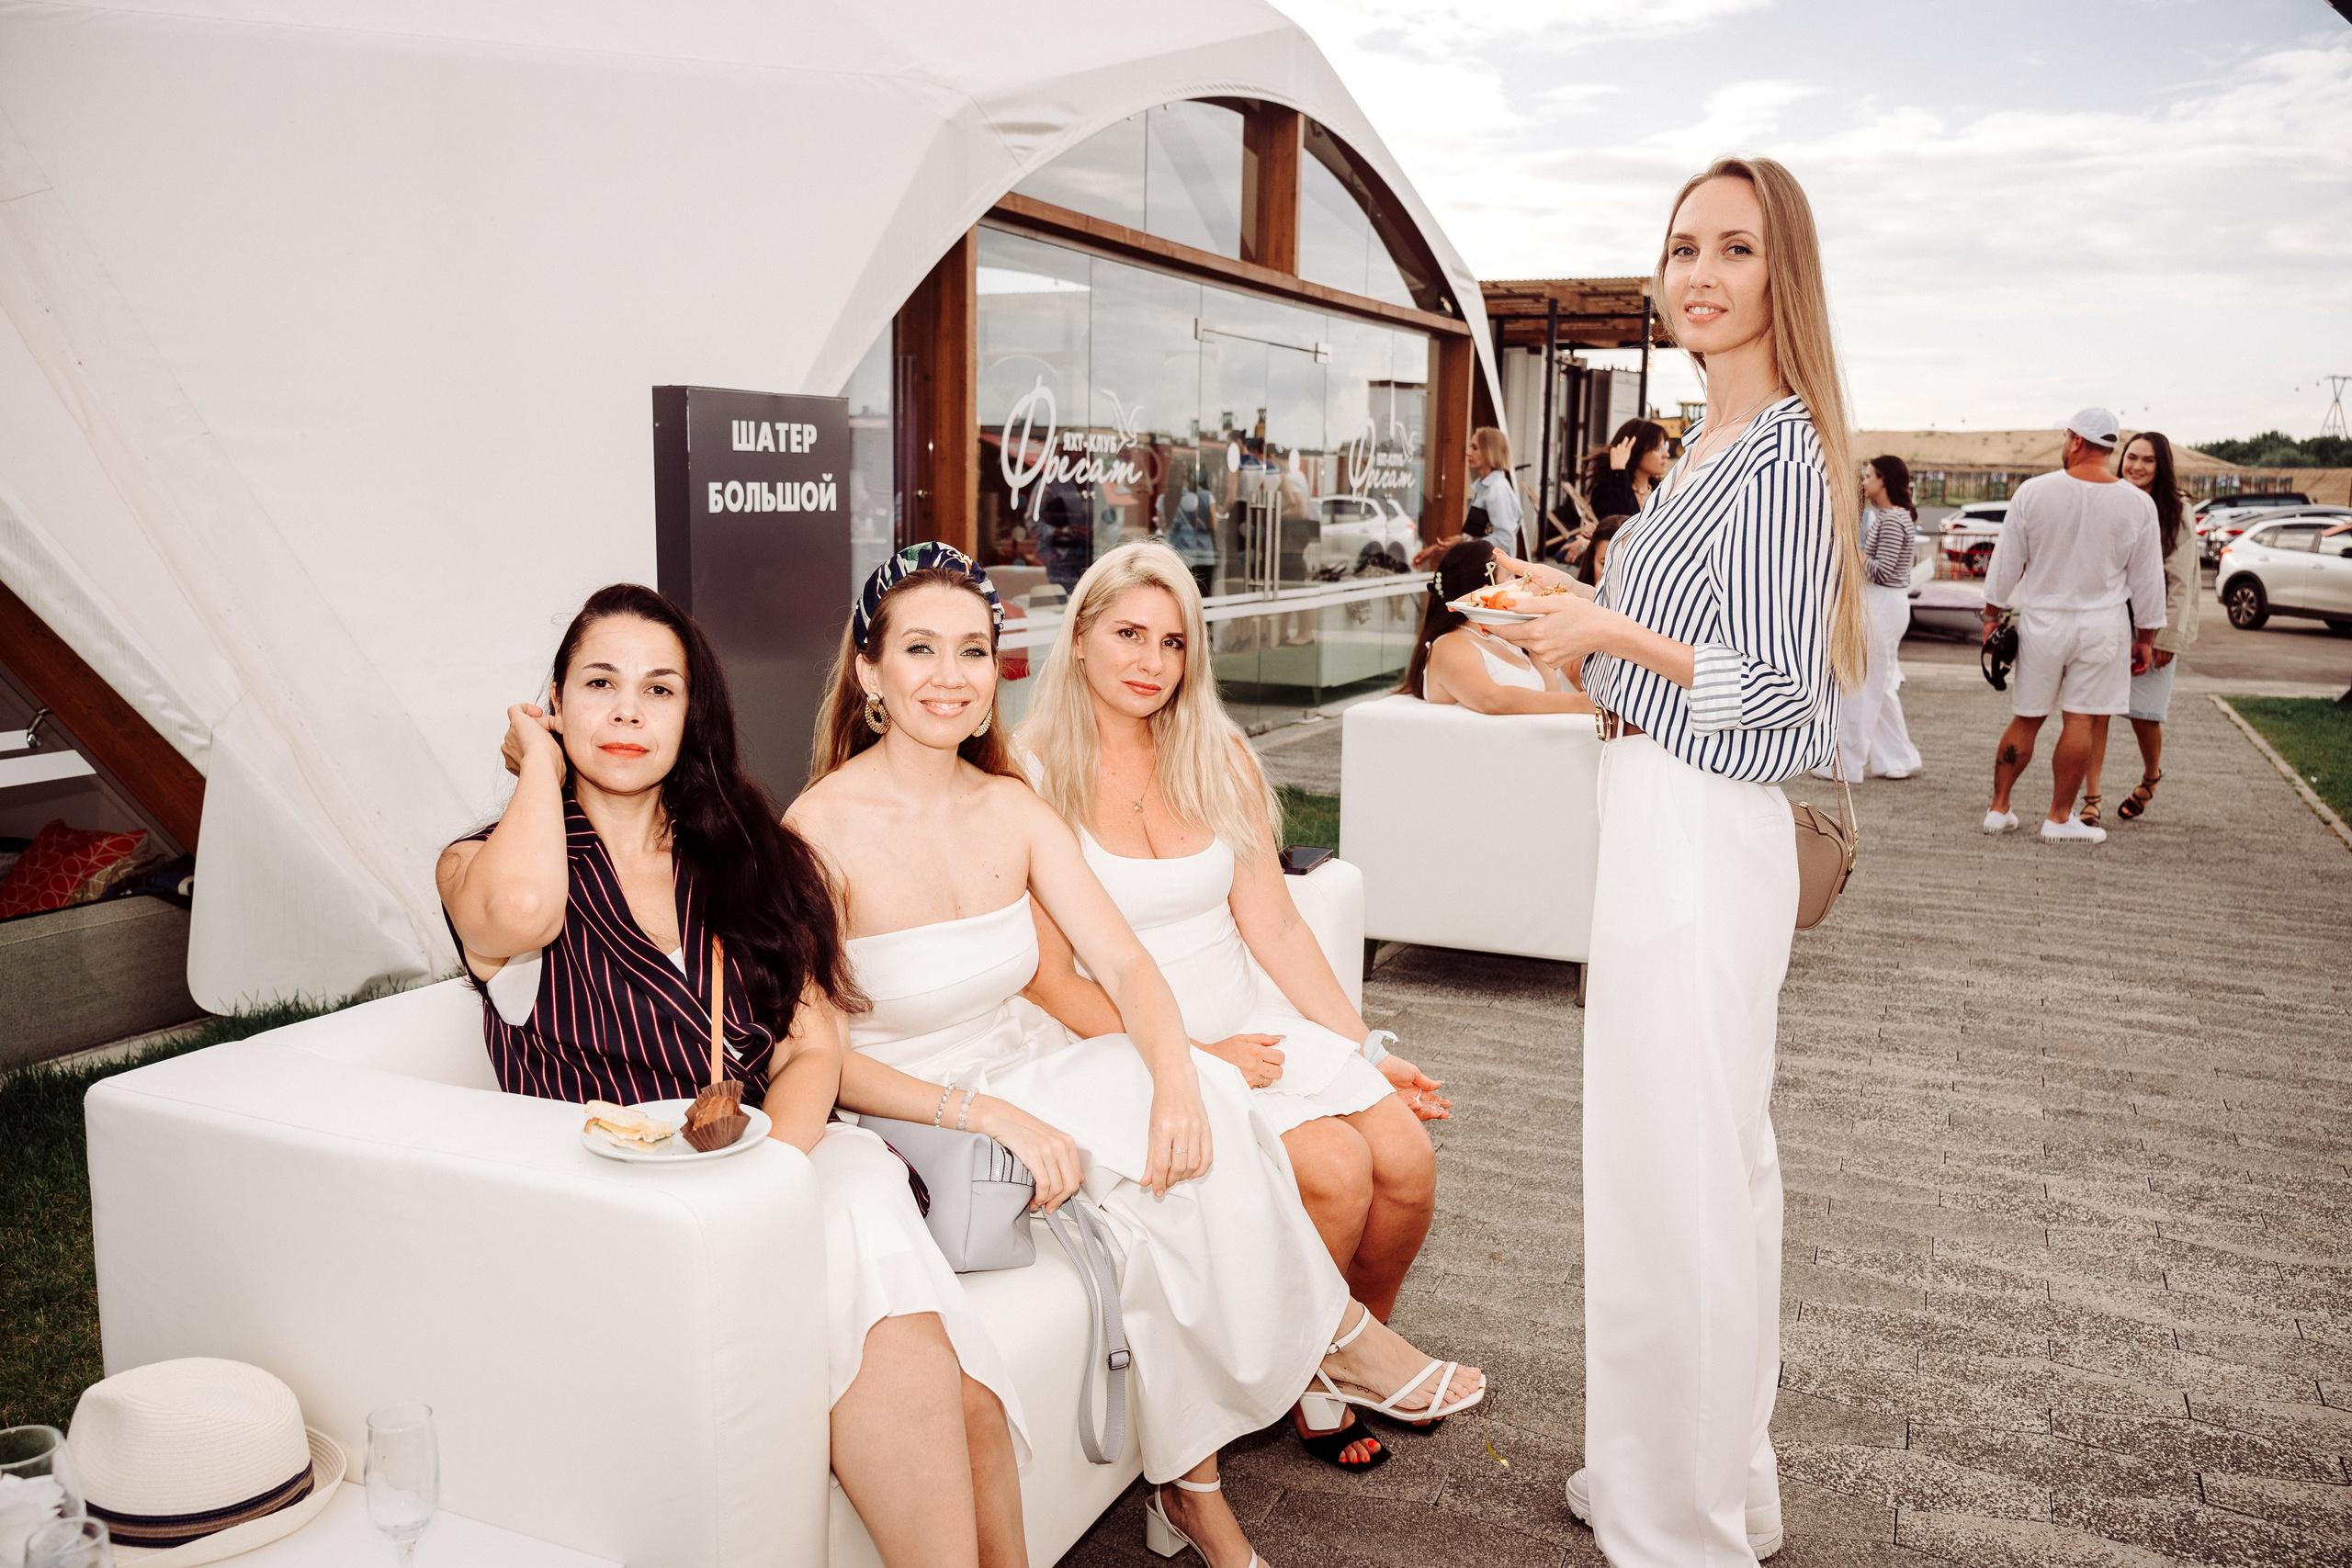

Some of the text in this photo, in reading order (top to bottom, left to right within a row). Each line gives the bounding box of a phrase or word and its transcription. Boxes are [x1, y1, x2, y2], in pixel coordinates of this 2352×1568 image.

[732, 420, 818, 453] ШАТЕР
[1001, 375, 1143, 522] Фрегат
[1063, 431, 1117, 454] ЯХТ-КЛУБ
[708, 473, 837, 513] БОЛЬШОЙ
